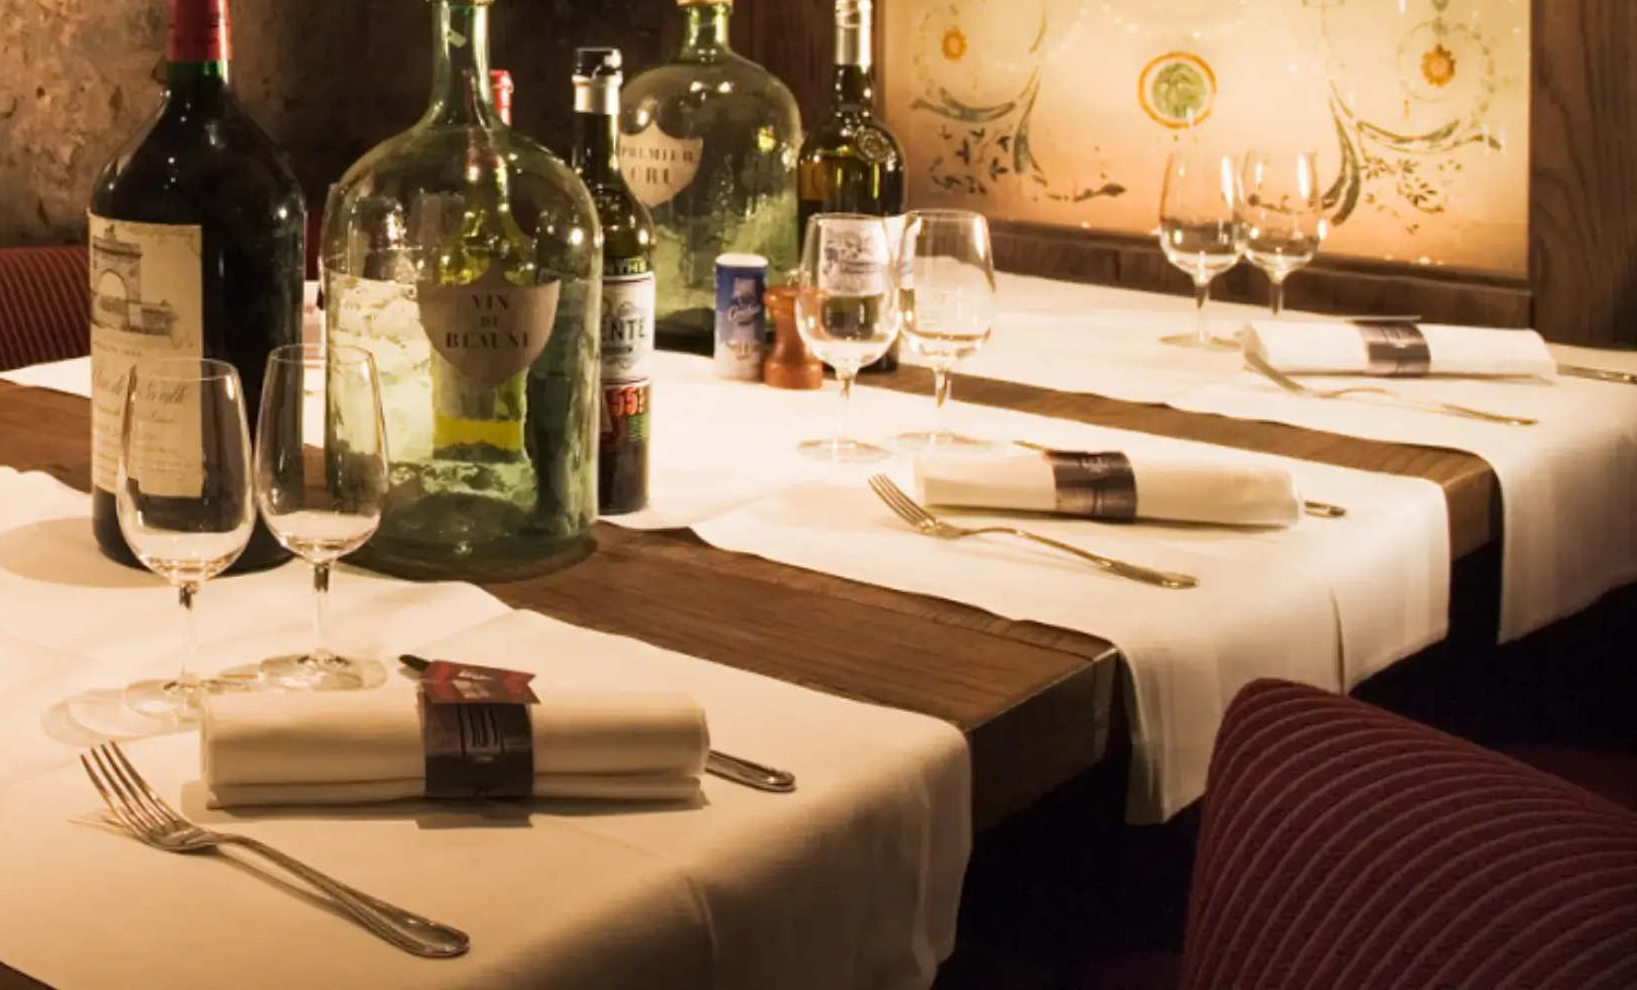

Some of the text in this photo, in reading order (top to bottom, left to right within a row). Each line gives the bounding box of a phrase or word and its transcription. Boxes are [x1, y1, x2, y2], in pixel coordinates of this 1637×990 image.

[620, 146, 694, 162] PREMIER
[629, 167, 670, 184] CRU
[470, 294, 511, 309] VIN
[446, 332, 530, 349] BEAUNE
